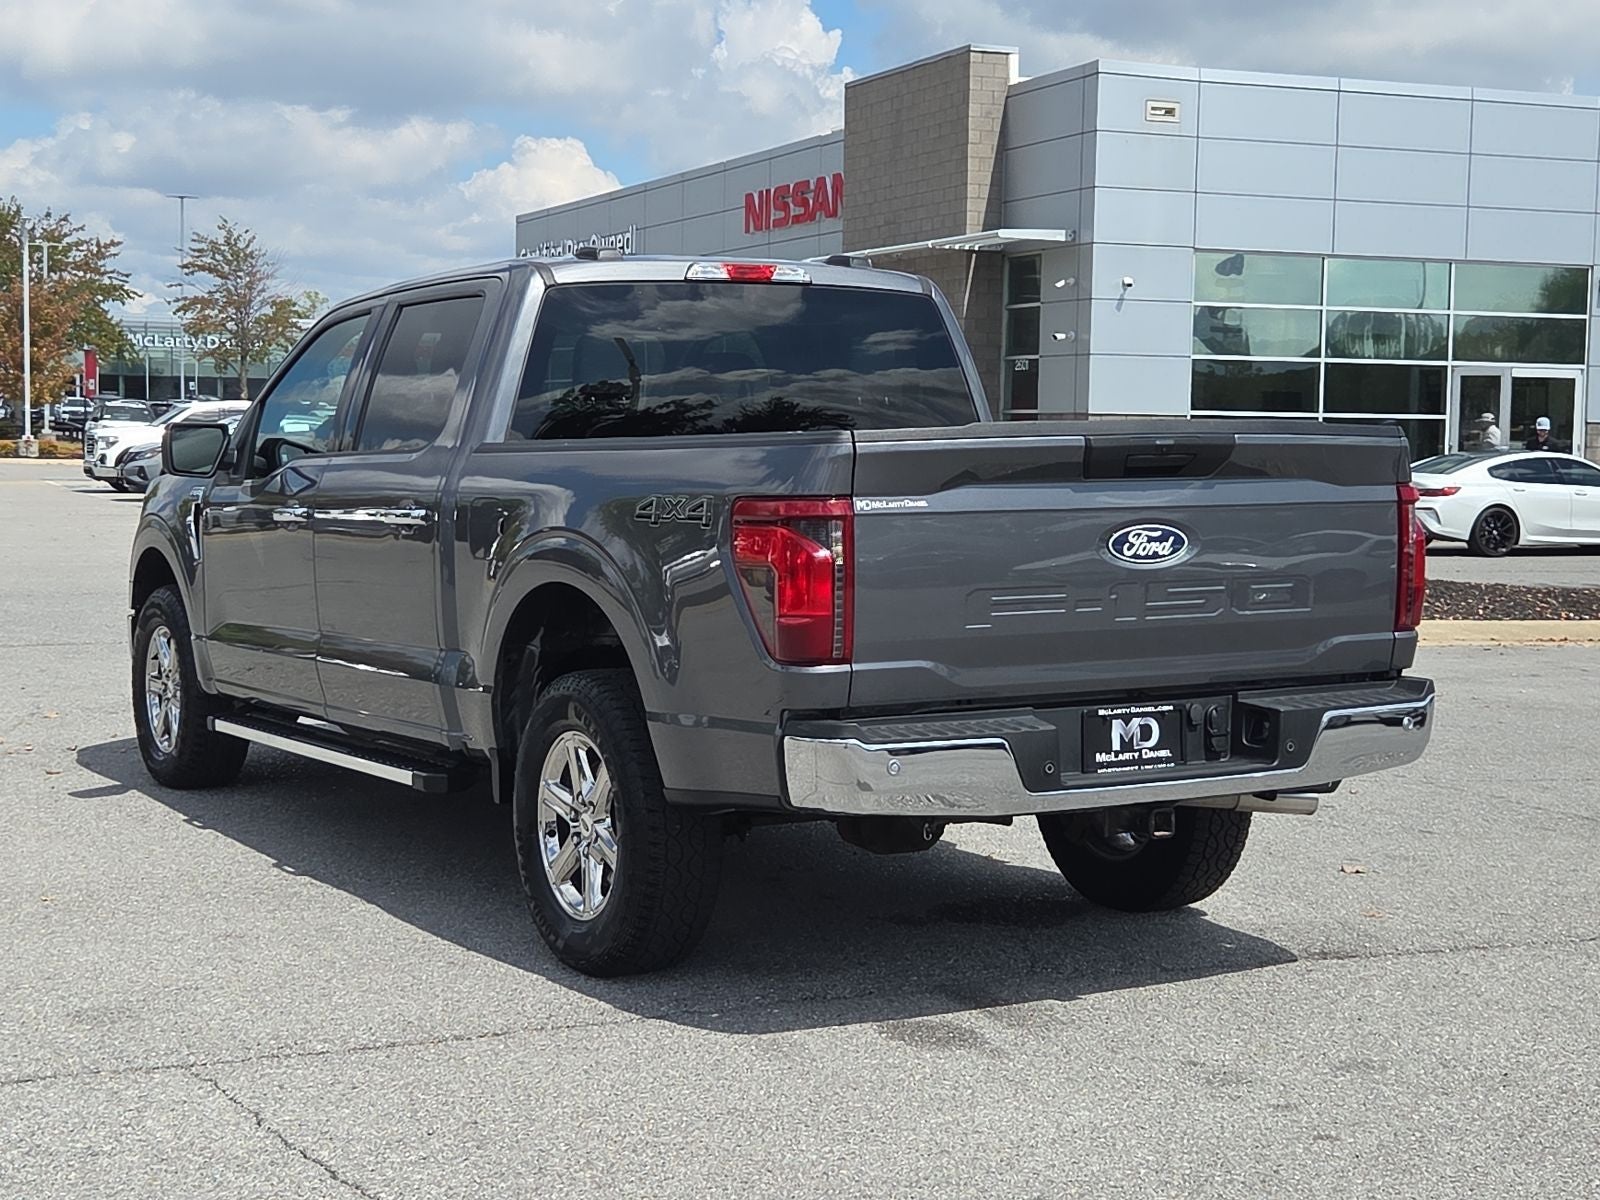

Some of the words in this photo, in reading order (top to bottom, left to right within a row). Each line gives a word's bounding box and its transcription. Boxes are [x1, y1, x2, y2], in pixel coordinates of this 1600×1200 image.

[744, 171, 844, 234] NISSAN
[126, 332, 202, 352] McLarty
[1122, 529, 1175, 556] Ford
[965, 574, 1313, 629] F-150
[1141, 748, 1173, 759] DANIEL
